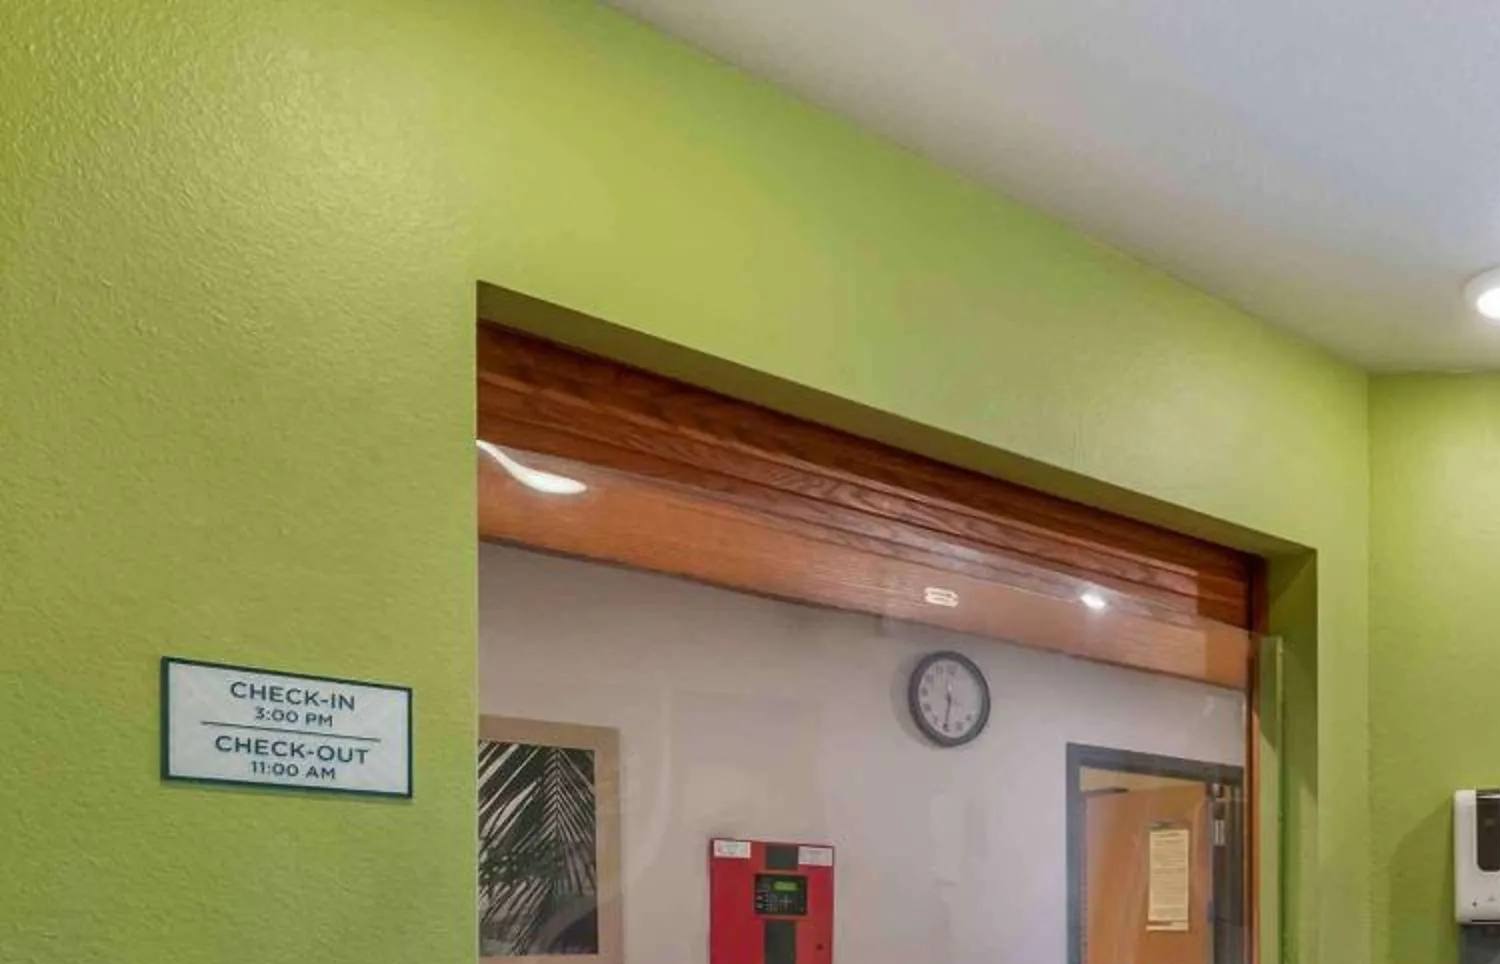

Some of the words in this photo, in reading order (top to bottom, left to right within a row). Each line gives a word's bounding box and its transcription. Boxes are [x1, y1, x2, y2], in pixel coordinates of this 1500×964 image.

[230, 681, 355, 711] CHECK-IN
[256, 706, 299, 724] 3:00
[304, 712, 333, 728] PM
[215, 735, 369, 765] CHECK-OUT
[250, 760, 299, 778] 11:00
[304, 765, 336, 780] AM
